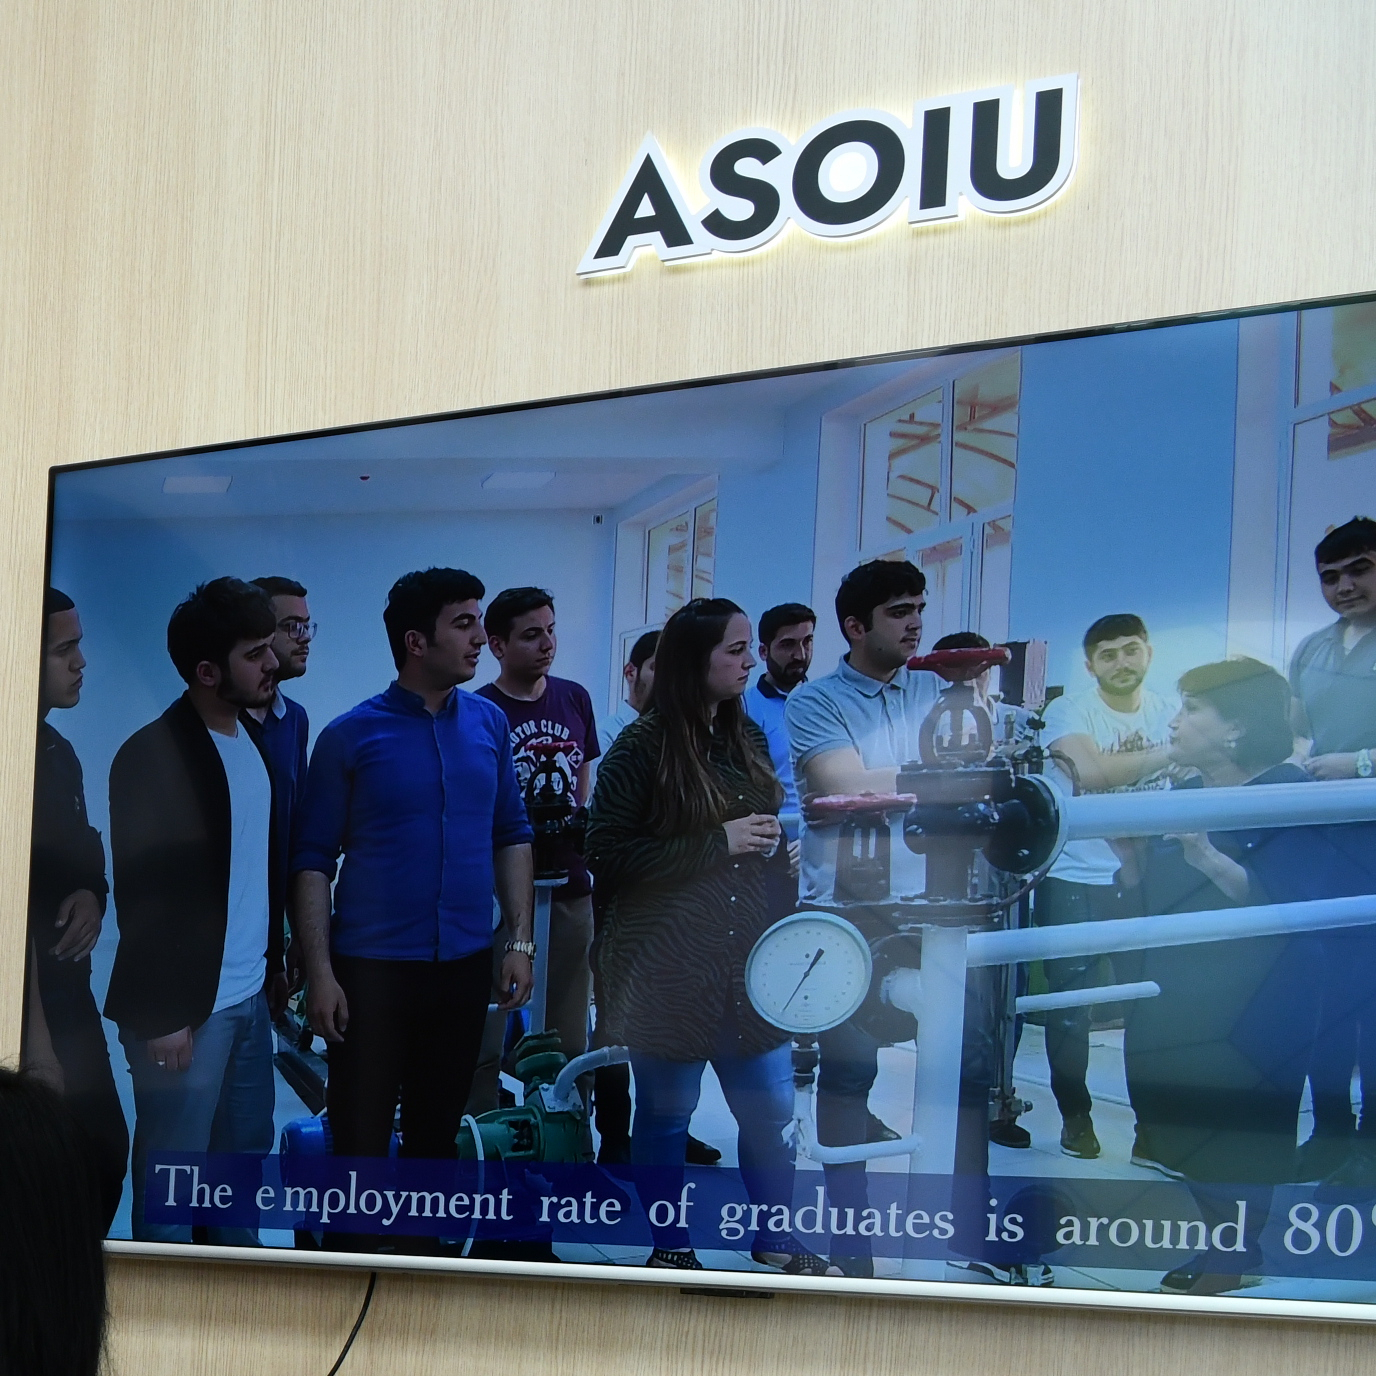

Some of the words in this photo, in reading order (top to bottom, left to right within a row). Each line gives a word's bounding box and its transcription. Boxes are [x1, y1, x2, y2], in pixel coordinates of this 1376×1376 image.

[593, 87, 1063, 259] ASOIU
[510, 720, 538, 744] OTOR
[541, 719, 569, 740] CLUB
[154, 1163, 235, 1209] The
[255, 1171, 514, 1226] employment
[539, 1189, 623, 1225] rate
[649, 1182, 696, 1229] of
[719, 1186, 956, 1241] graduates
[985, 1197, 1026, 1243] is
[1056, 1200, 1248, 1253] around
[1283, 1202, 1376, 1257] 80
